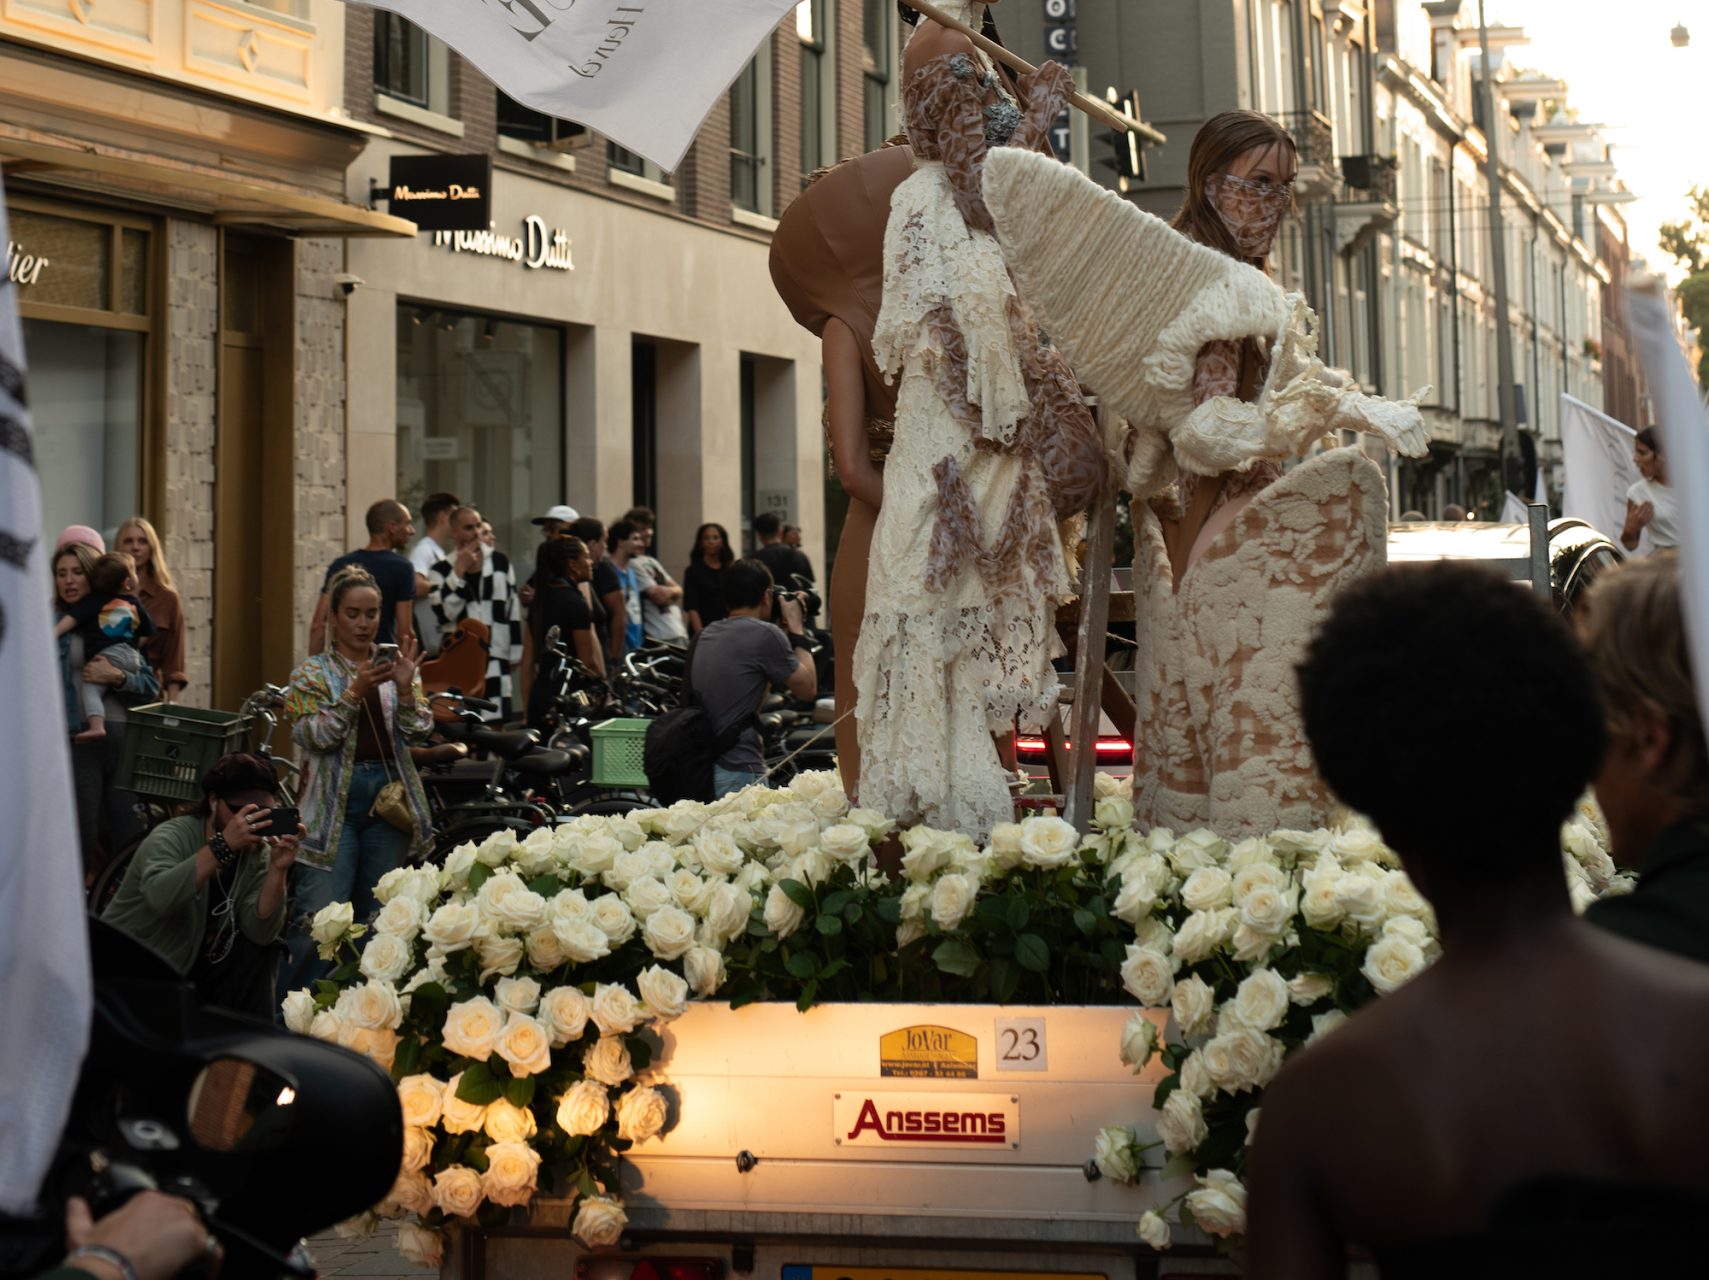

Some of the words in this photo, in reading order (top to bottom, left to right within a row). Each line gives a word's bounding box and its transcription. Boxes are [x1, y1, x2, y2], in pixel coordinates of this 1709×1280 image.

[394, 185, 448, 201] Massimo
[449, 184, 481, 200] Dutti
[525, 215, 574, 270] Dutti
[1001, 1028, 1041, 1061] 23
[848, 1099, 1006, 1142] Anssems
